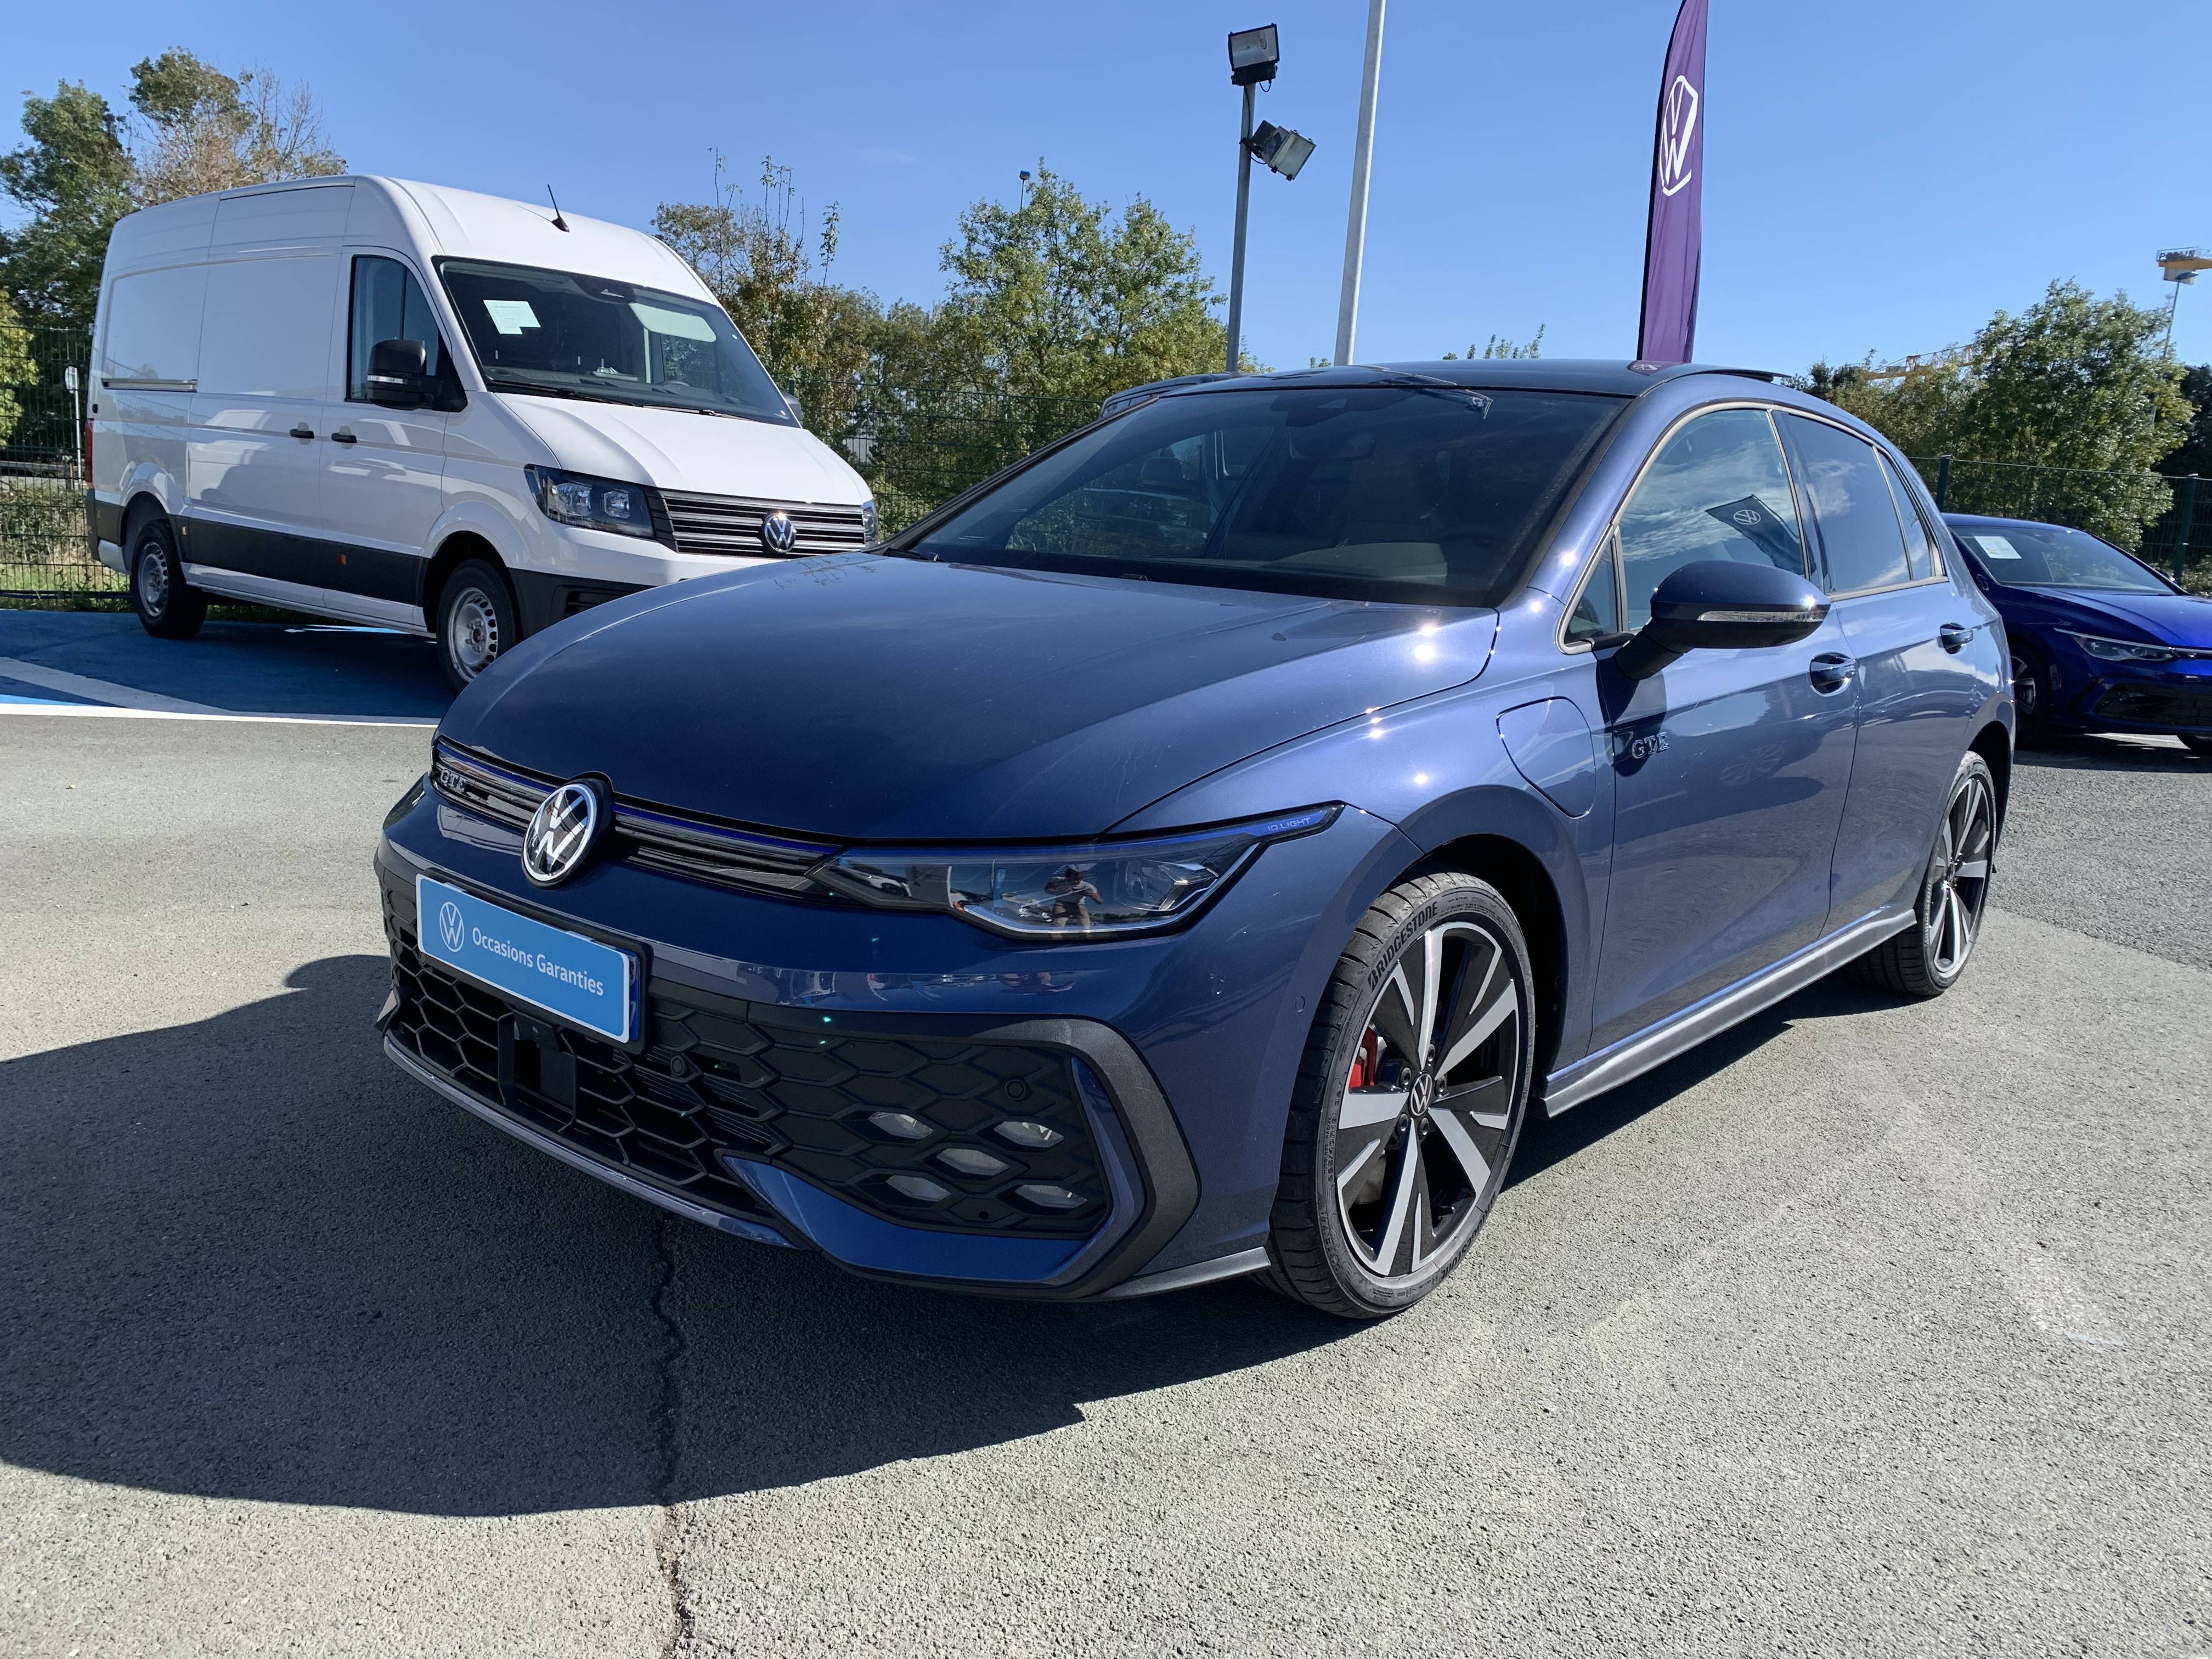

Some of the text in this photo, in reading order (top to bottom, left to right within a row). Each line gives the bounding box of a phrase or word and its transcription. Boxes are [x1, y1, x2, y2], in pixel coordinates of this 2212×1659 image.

[1632, 732, 1669, 759] GTE
[441, 769, 467, 792] GTE
[1268, 817, 1311, 832] IQ.LIGHT
[1368, 901, 1438, 992] BRIDGESTONE
[472, 927, 533, 968] Occasions
[537, 953, 603, 996] Garanties
